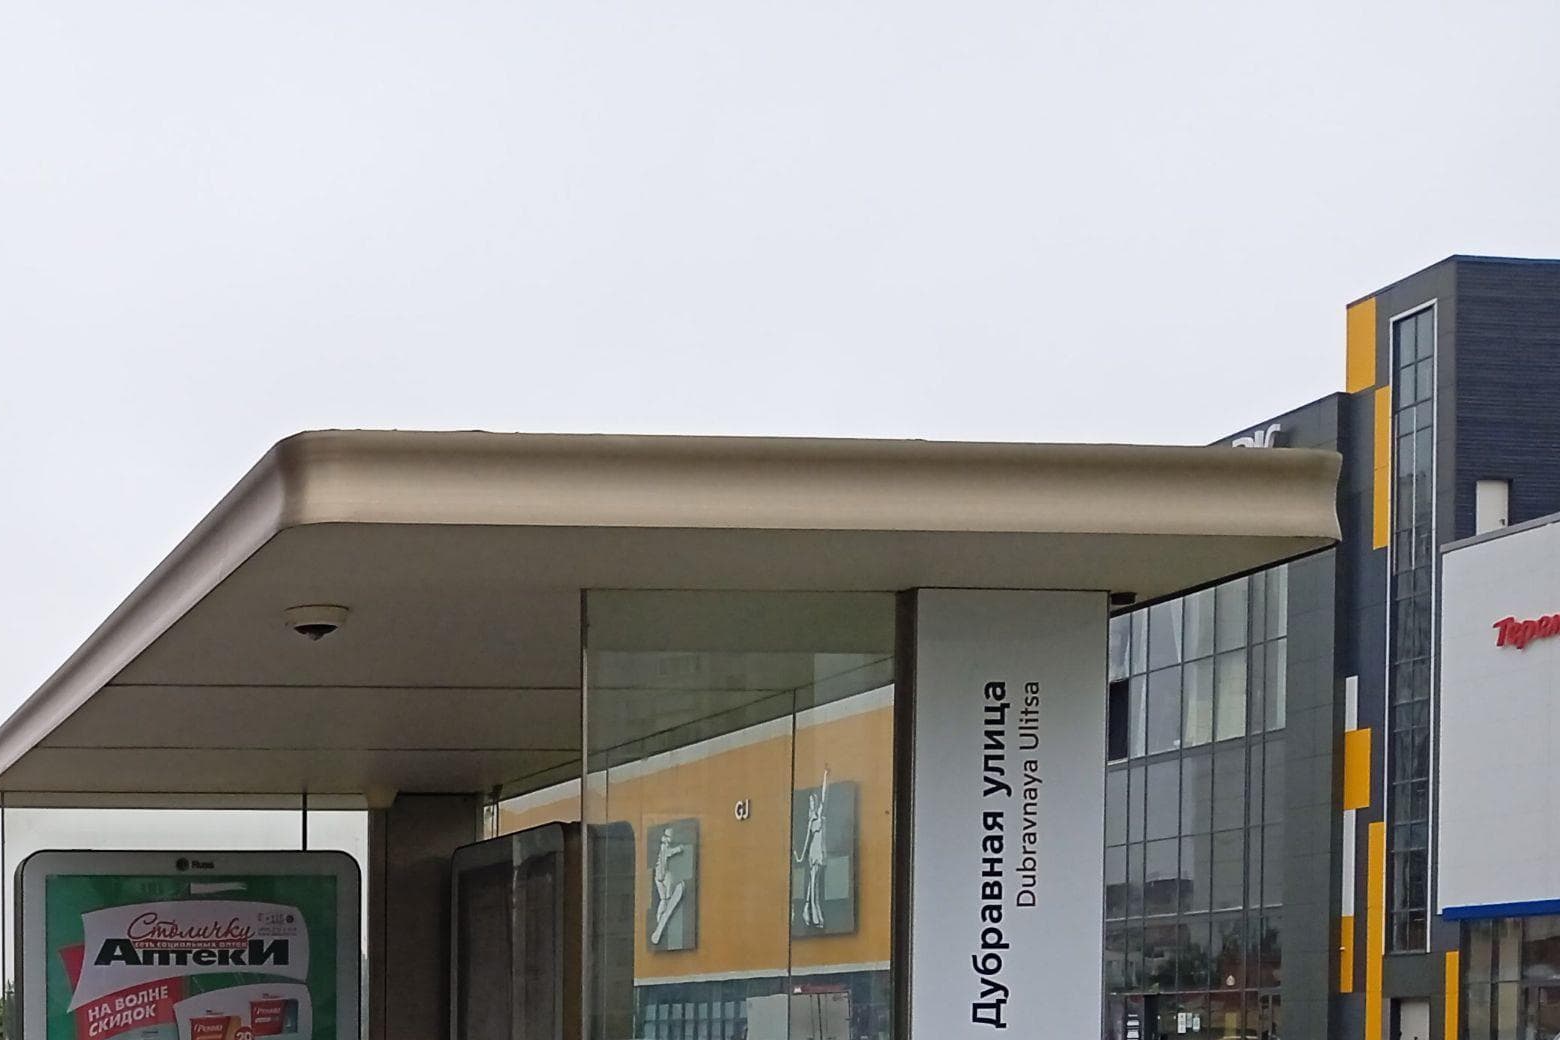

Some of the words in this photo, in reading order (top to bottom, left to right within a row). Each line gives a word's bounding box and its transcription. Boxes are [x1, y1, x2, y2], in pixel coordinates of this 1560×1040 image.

[983, 680, 1012, 797] улица
[1018, 680, 1040, 751] Ulitsa
[1016, 760, 1042, 908] Dubravnaya
[127, 912, 256, 941] Столички
[971, 811, 1010, 1029] Дубравная
[88, 1003, 112, 1022] НА
[115, 986, 168, 1011] ВОЛНЕ
[89, 1004, 156, 1037] СКИДОК
